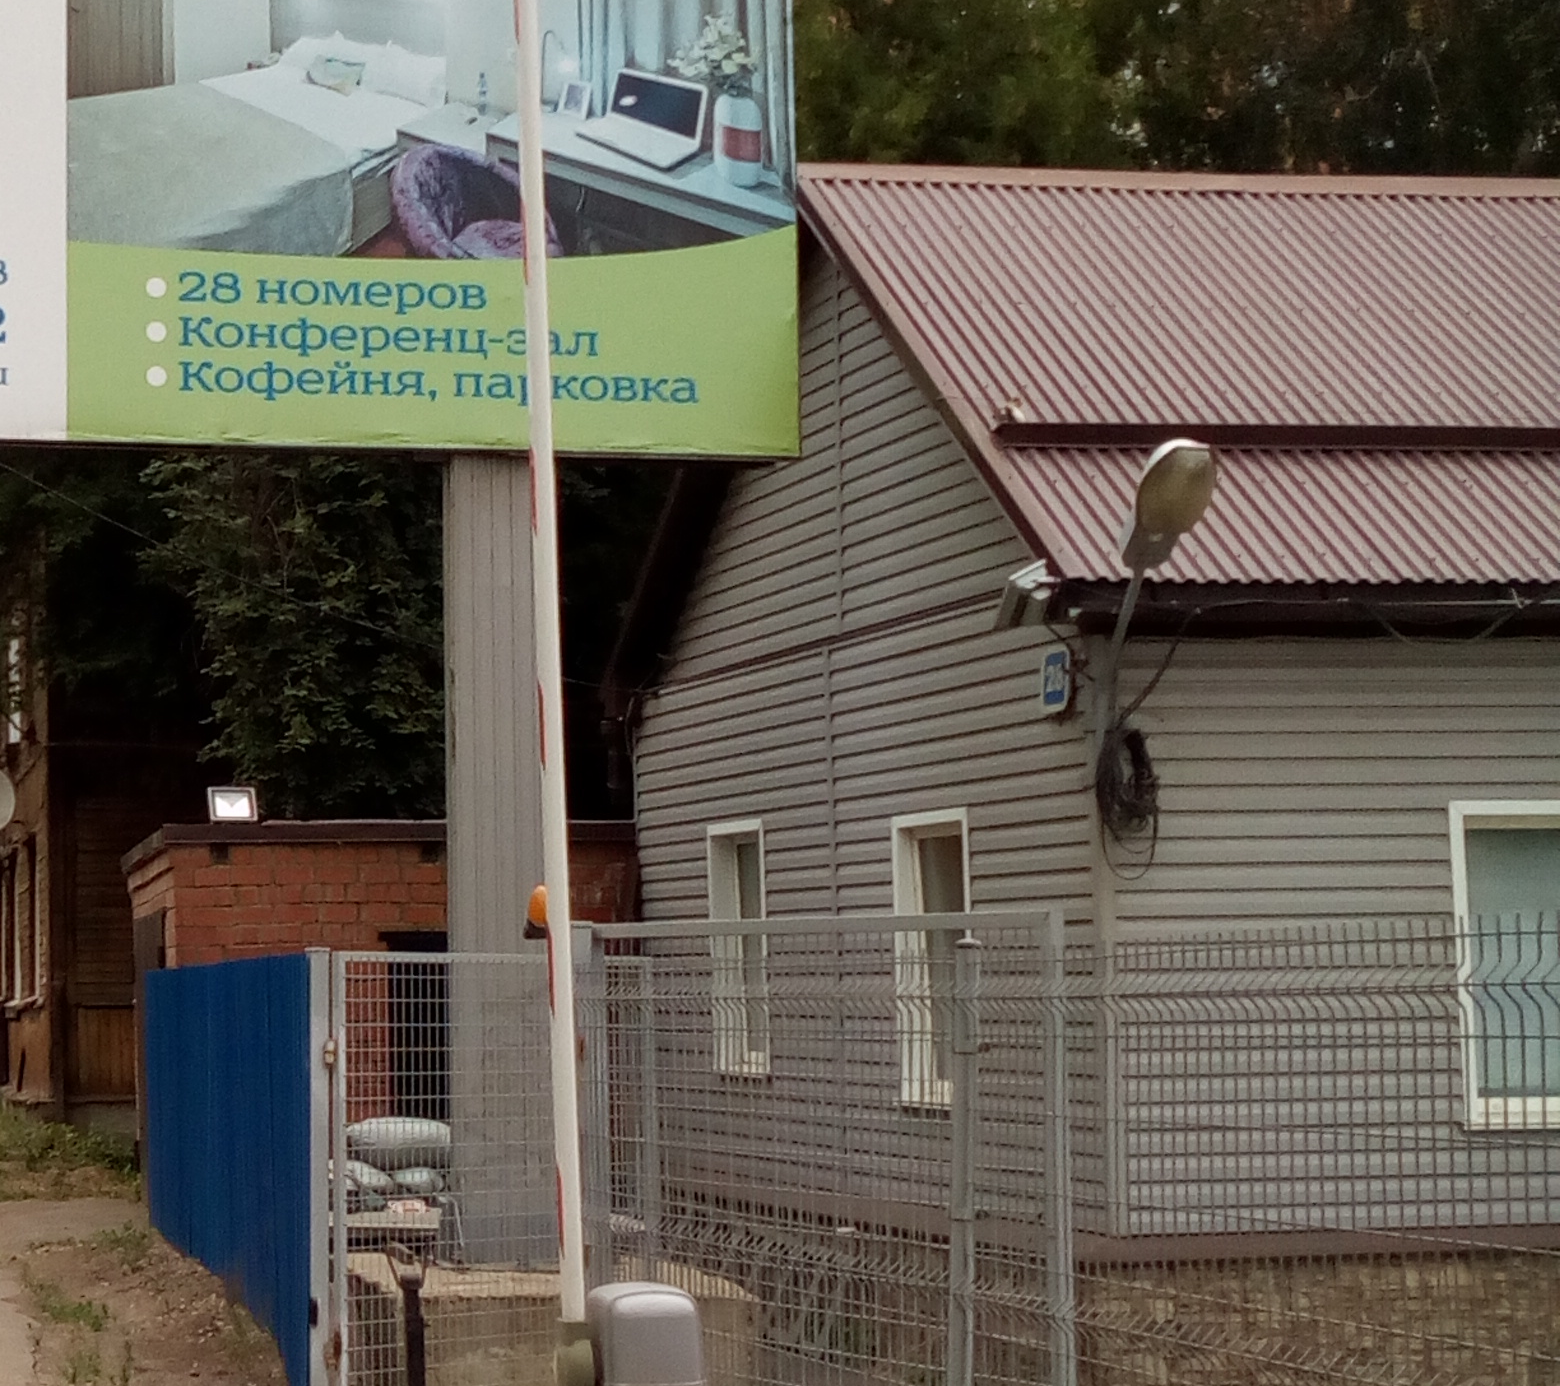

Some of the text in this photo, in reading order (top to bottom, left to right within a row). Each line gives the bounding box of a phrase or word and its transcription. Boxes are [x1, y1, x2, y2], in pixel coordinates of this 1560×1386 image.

[178, 270, 488, 315] 28 номеров
[178, 360, 438, 402] Кофейня,
